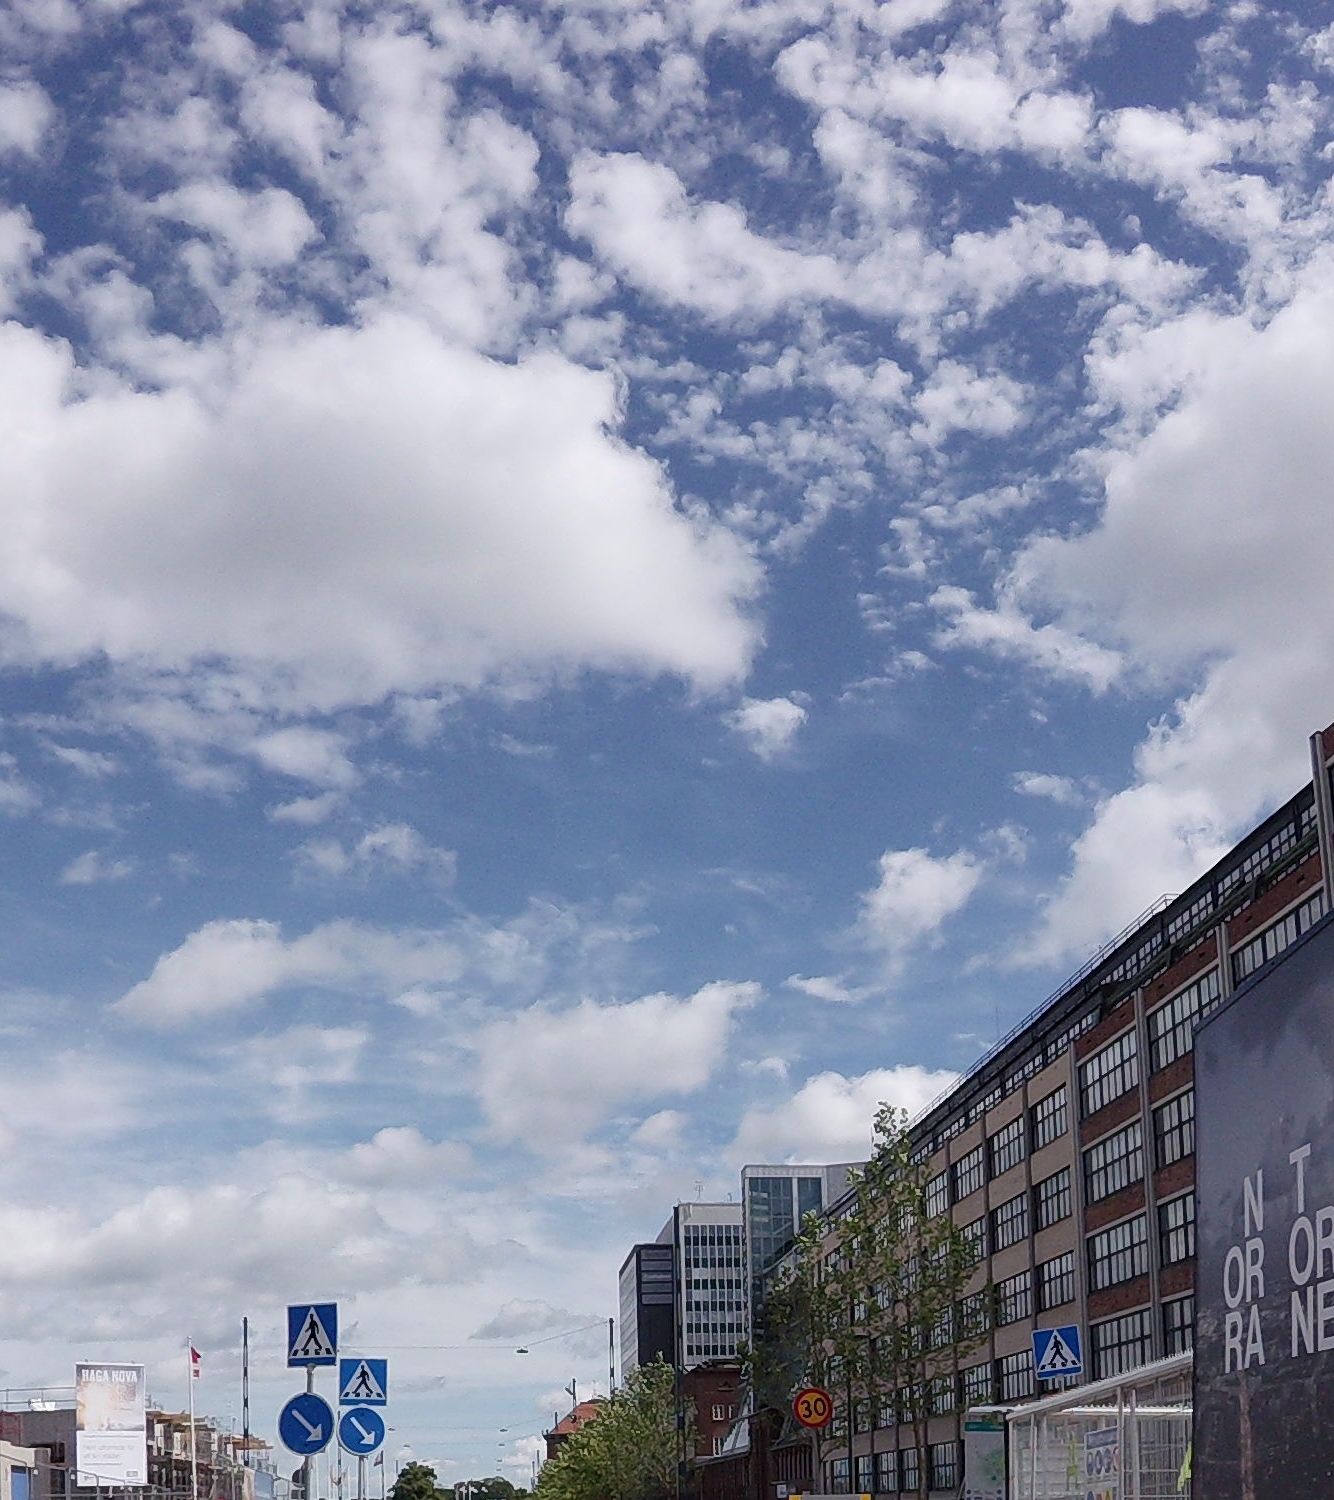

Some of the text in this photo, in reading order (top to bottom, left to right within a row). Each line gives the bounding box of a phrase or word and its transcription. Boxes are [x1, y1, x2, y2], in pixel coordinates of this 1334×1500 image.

[81, 1368, 138, 1384] HAGA NOVA
[800, 1397, 827, 1419] 30
